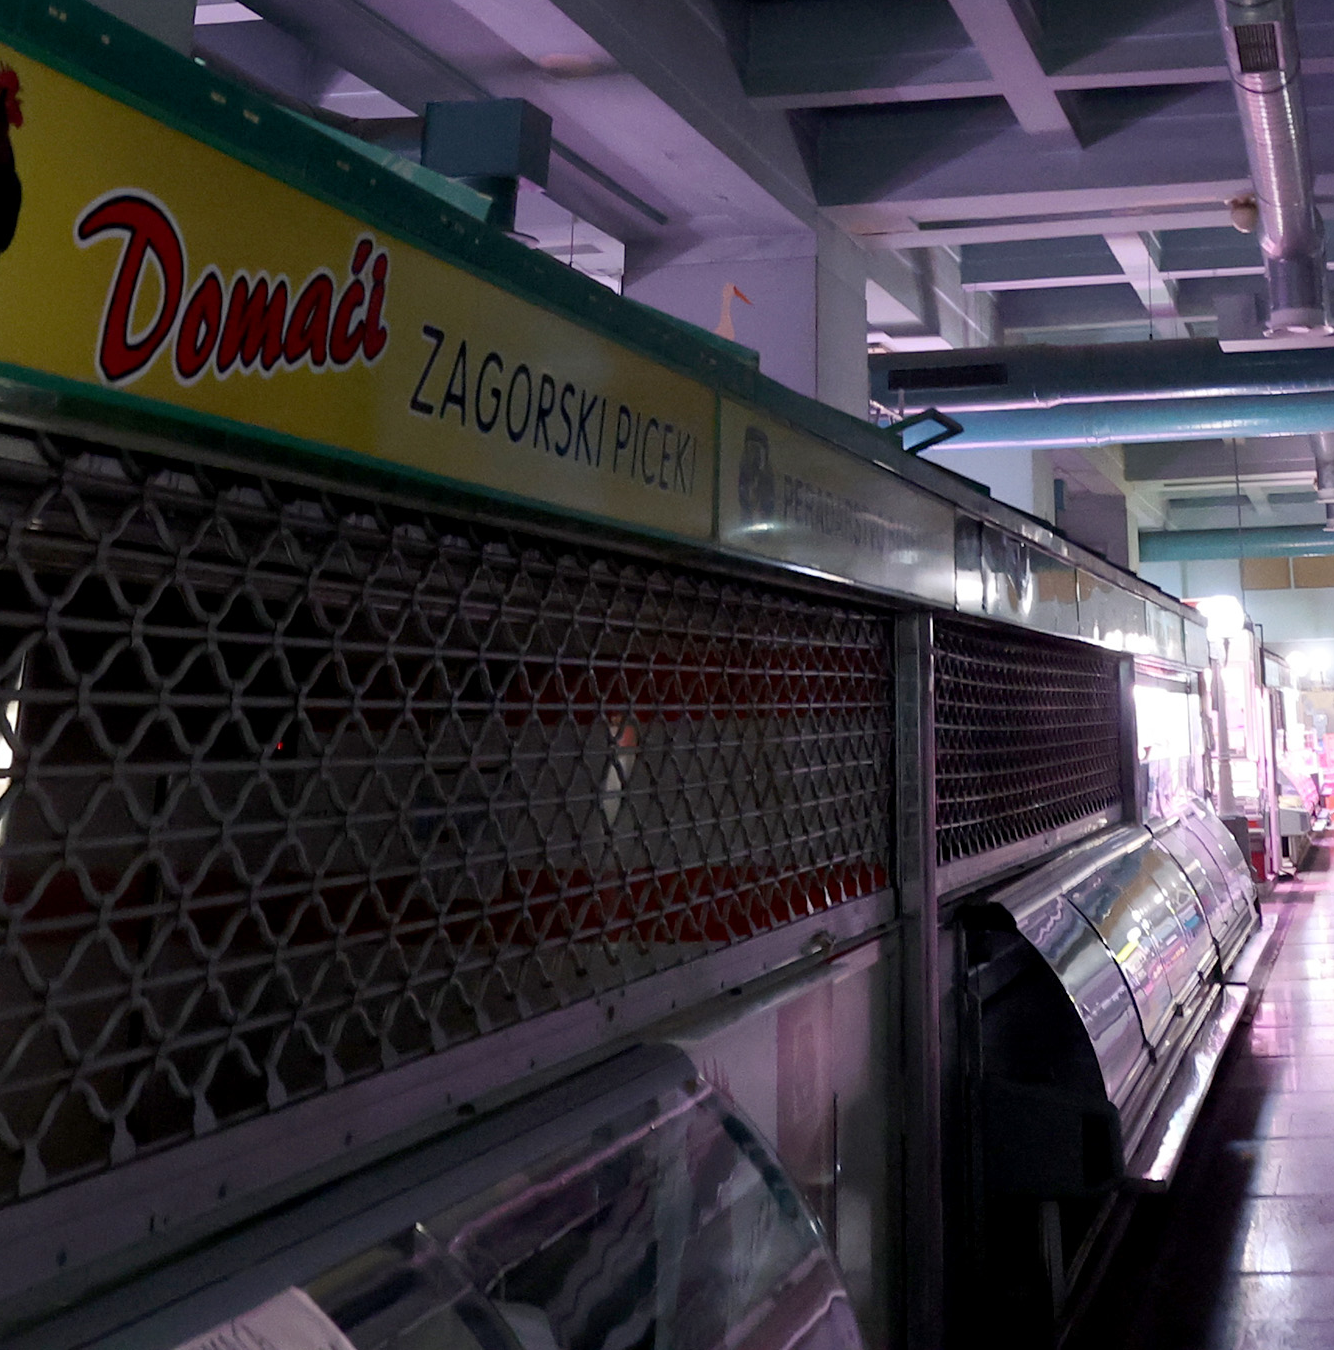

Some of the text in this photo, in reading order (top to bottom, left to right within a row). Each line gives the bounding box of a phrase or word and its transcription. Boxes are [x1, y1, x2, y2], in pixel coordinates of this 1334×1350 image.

[75, 191, 389, 385] Domaći
[410, 324, 698, 498] ZAGORSKI PICEKI
